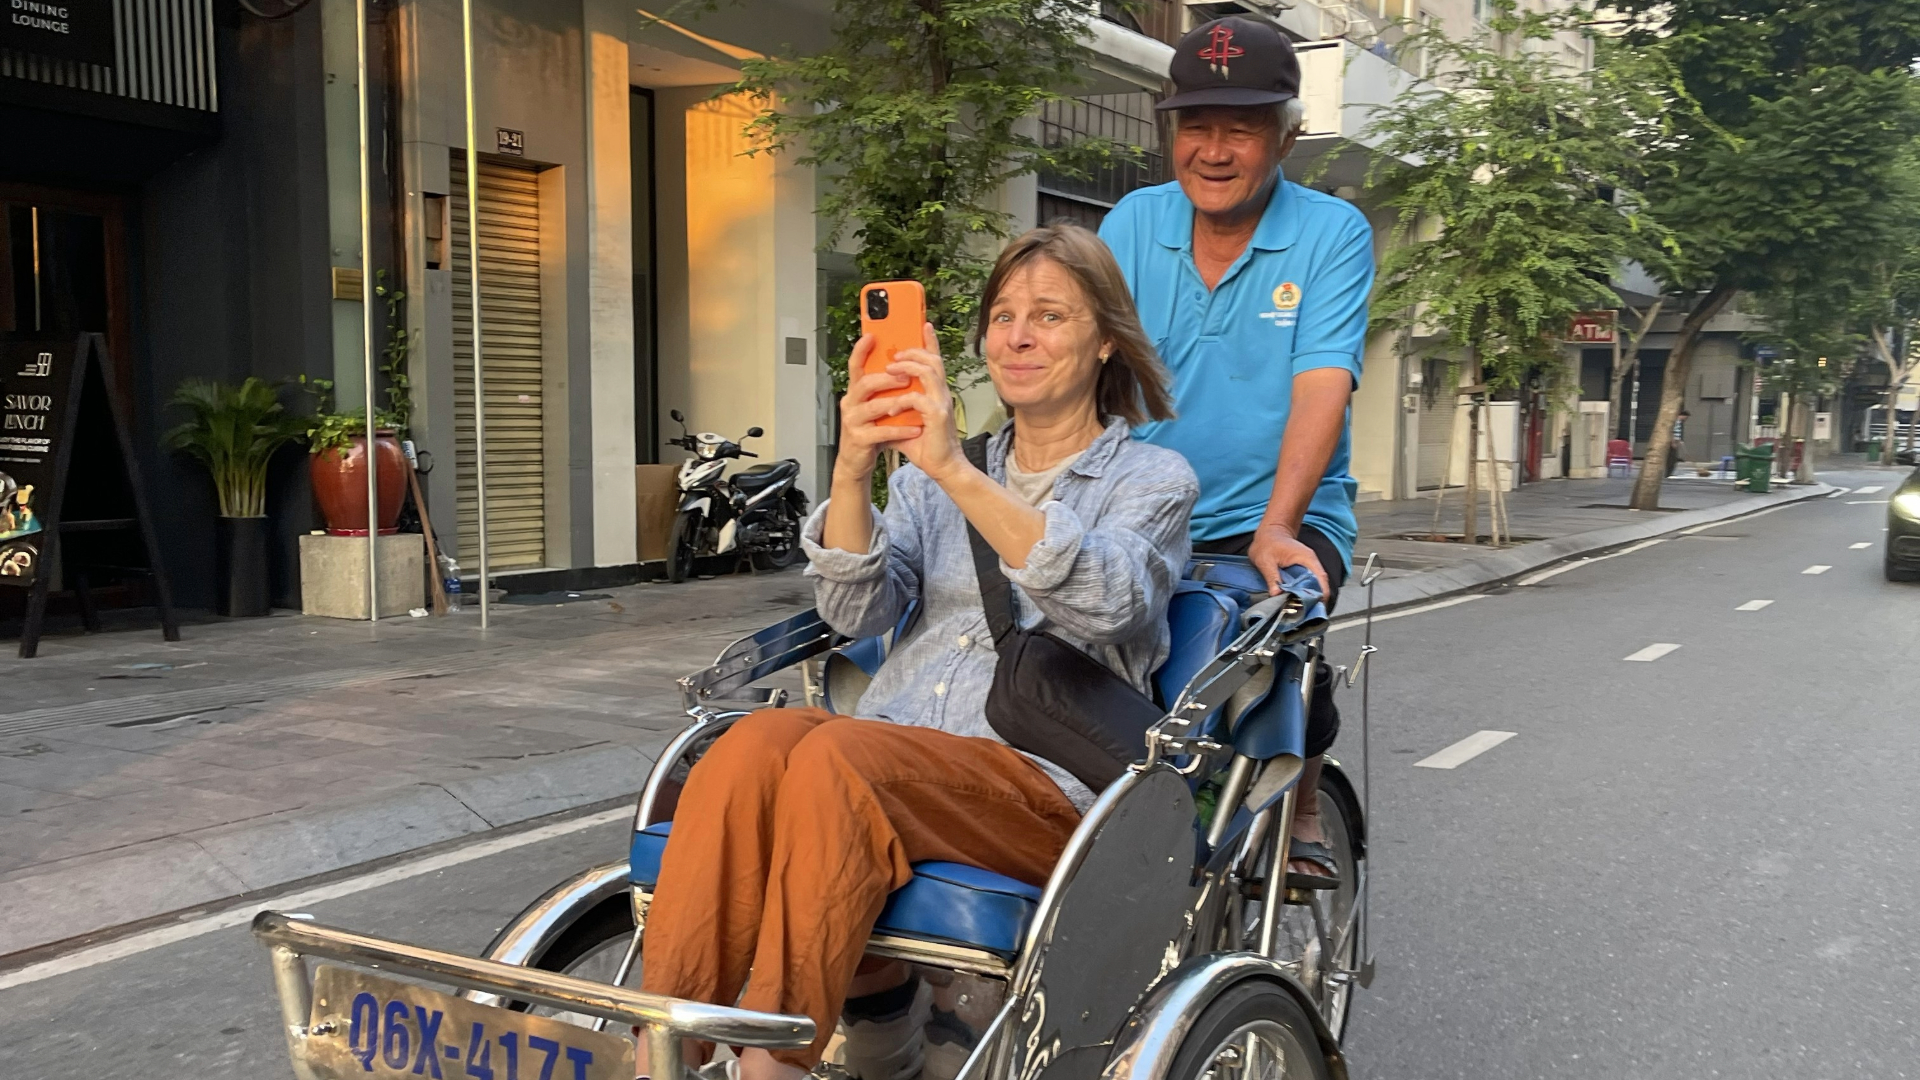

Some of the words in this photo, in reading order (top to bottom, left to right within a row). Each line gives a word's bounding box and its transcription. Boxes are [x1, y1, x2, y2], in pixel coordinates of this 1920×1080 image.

[12, 0, 69, 19] DINING
[12, 13, 70, 34] LOUNGE
[4, 394, 52, 411] SAVOR
[4, 413, 45, 431] LUNCH
